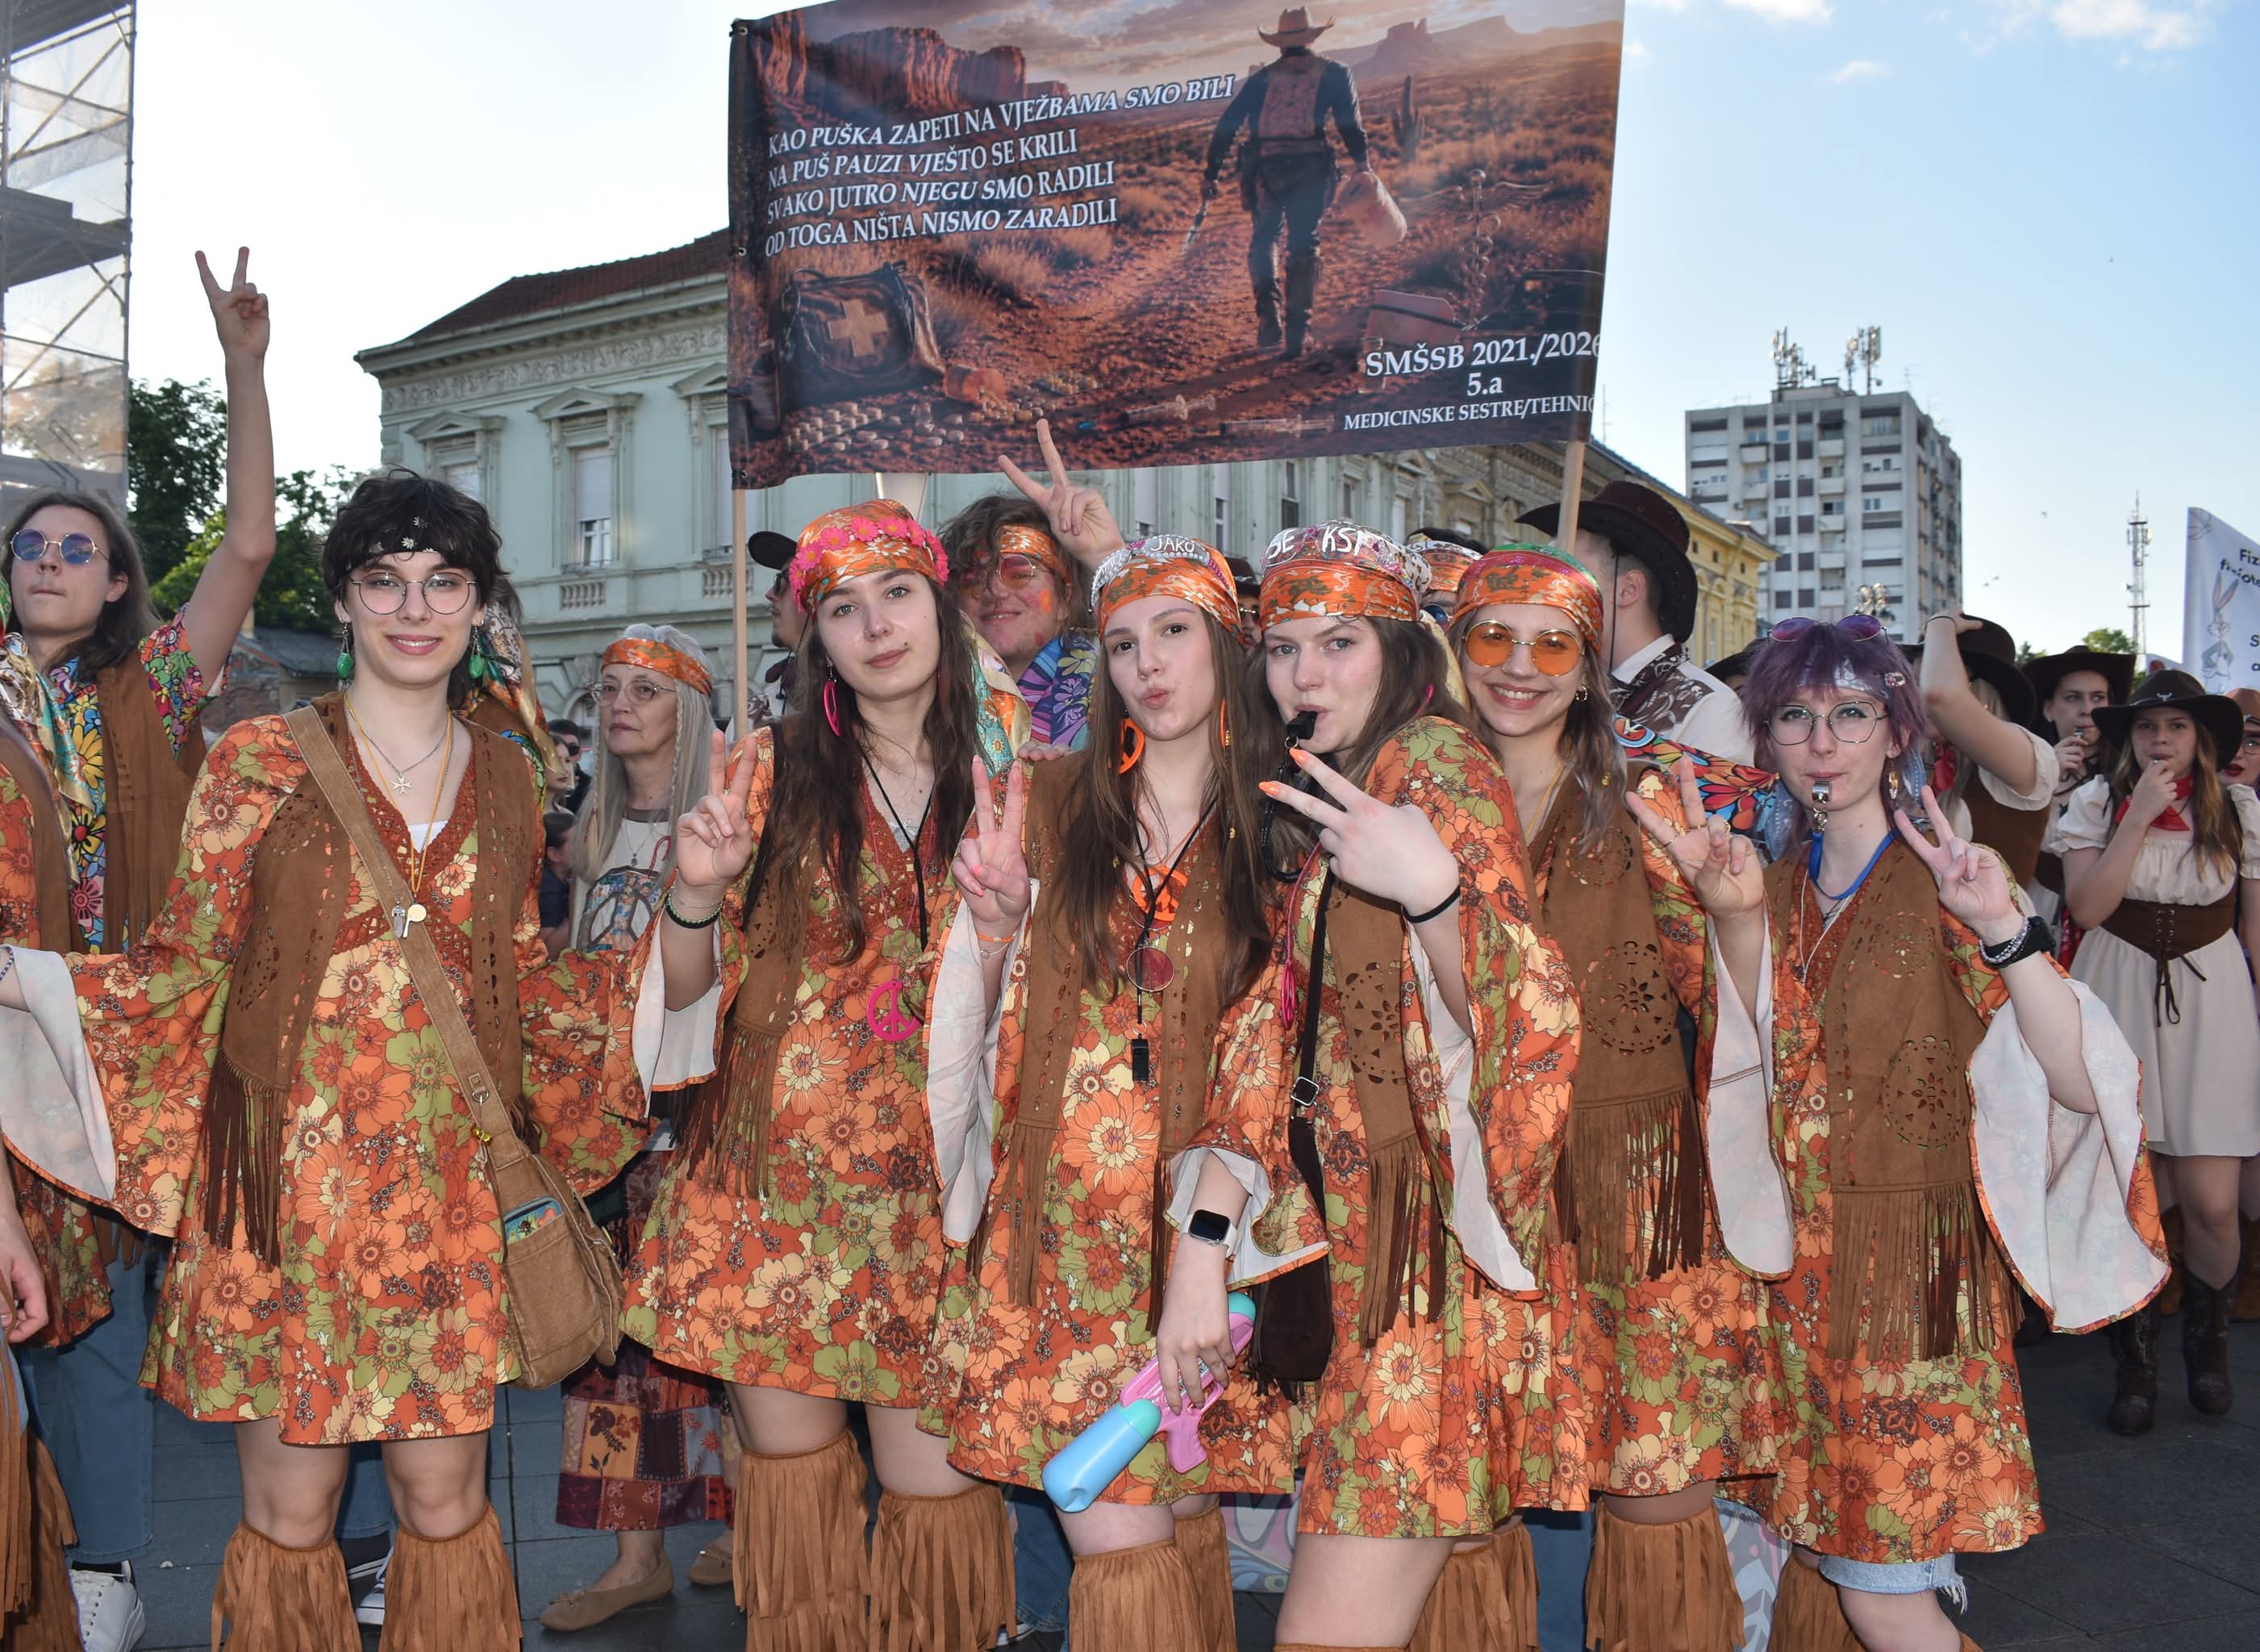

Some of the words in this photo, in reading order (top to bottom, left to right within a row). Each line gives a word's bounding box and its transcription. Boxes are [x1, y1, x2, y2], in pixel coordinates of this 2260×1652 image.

[769, 129, 805, 158] KAO
[811, 122, 883, 148] PUŠKA
[888, 114, 961, 145] ZAPETI
[964, 109, 996, 134] NA
[999, 92, 1120, 130] VJEŽBAMA
[1124, 84, 1181, 110] SMO
[1186, 75, 1236, 102] BILI
[769, 165, 789, 191] NA
[792, 151, 830, 182] PUŠ
[833, 153, 903, 177] PAUZI
[909, 145, 987, 177] VJEŠTO
[991, 140, 1015, 166] SE
[1019, 128, 1079, 160] KRILI
[766, 194, 824, 225] SVAKO
[827, 182, 898, 215] JUTRO
[900, 181, 977, 206] NJEGU
[980, 174, 1034, 199] SMO
[1038, 161, 1115, 194] RADILI
[765, 232, 785, 258] OD
[788, 221, 849, 249] TOGA
[852, 211, 917, 244] NIŠTA
[921, 210, 1001, 235] NISMO
[1003, 198, 1118, 230] ZARADILI
[1366, 343, 1464, 377] SMŠSB
[1466, 372, 1503, 396] 5.a
[1344, 405, 1455, 431] MEDICINSKE
[1150, 537, 1195, 553] JAKO
